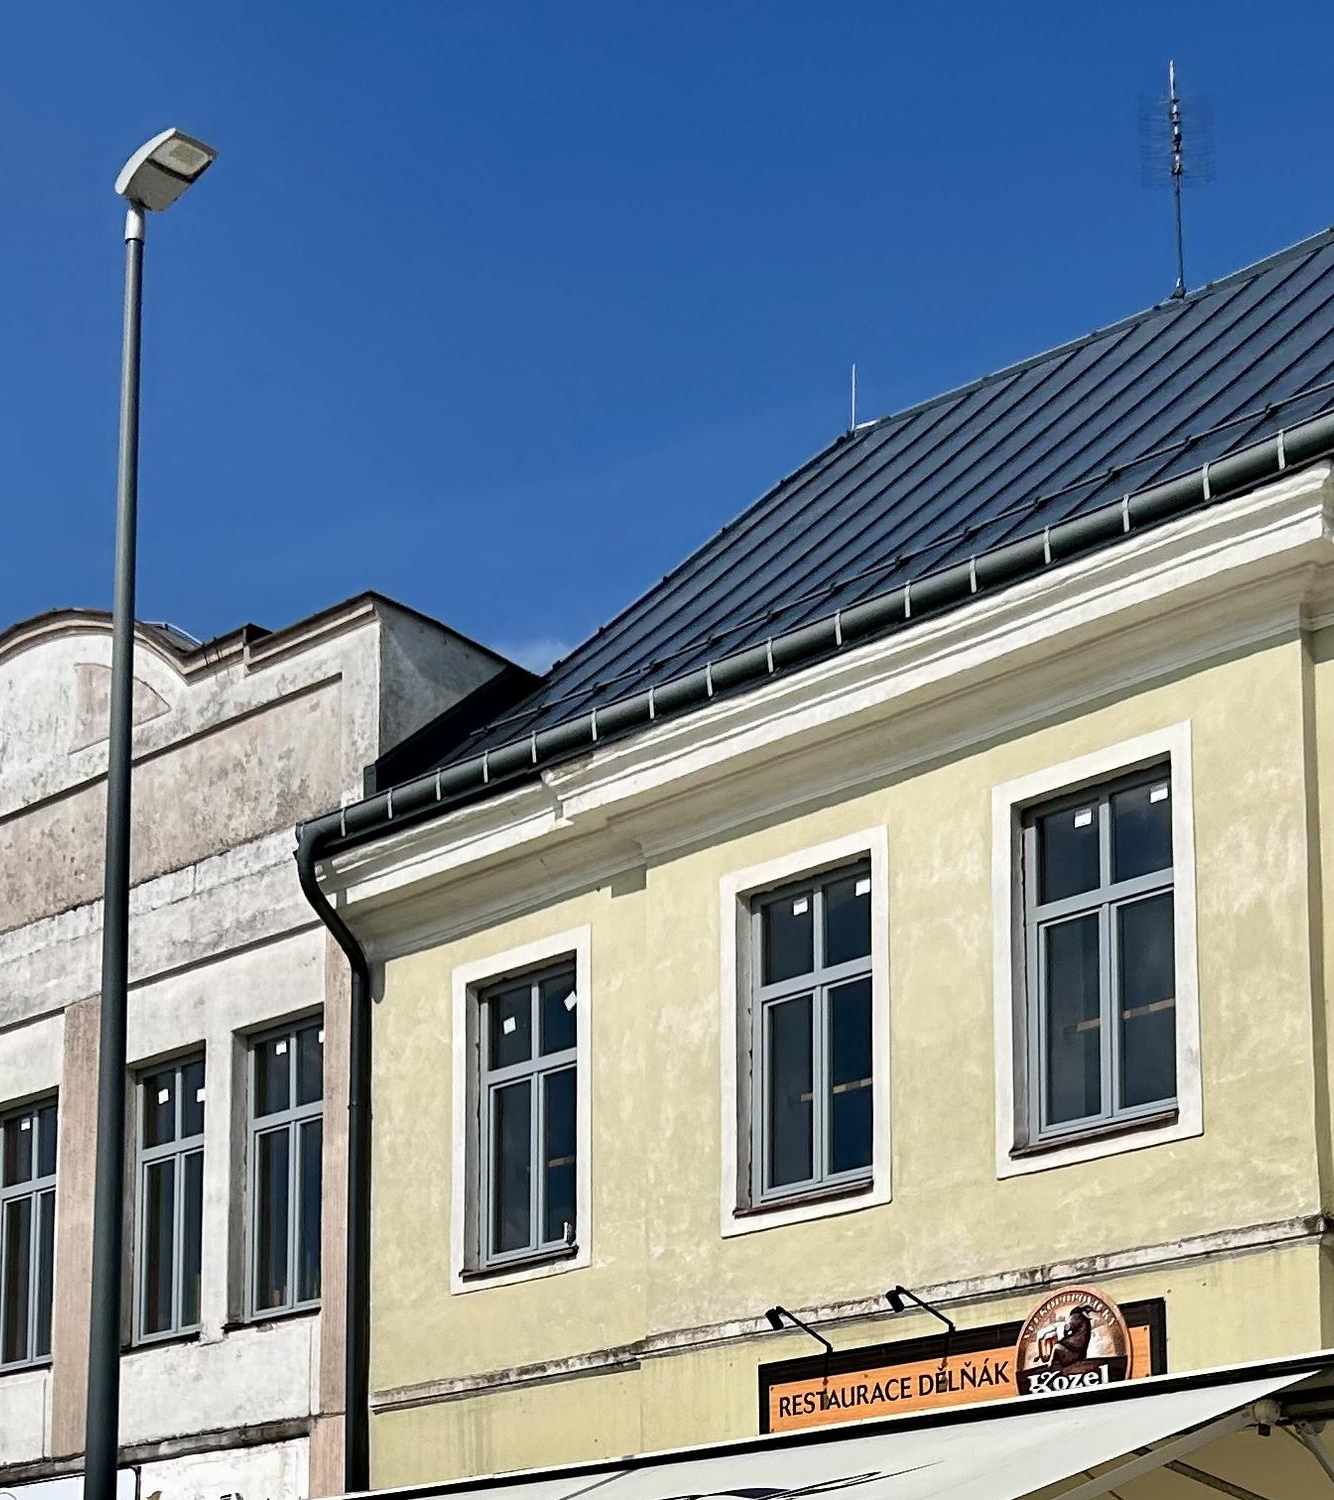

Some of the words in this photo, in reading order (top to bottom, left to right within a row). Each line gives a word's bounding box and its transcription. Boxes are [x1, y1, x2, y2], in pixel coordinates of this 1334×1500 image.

[778, 1378, 912, 1419] RESTAURACE
[918, 1358, 1011, 1394] DĚLŇÁK
[1027, 1363, 1110, 1395] Kozel
